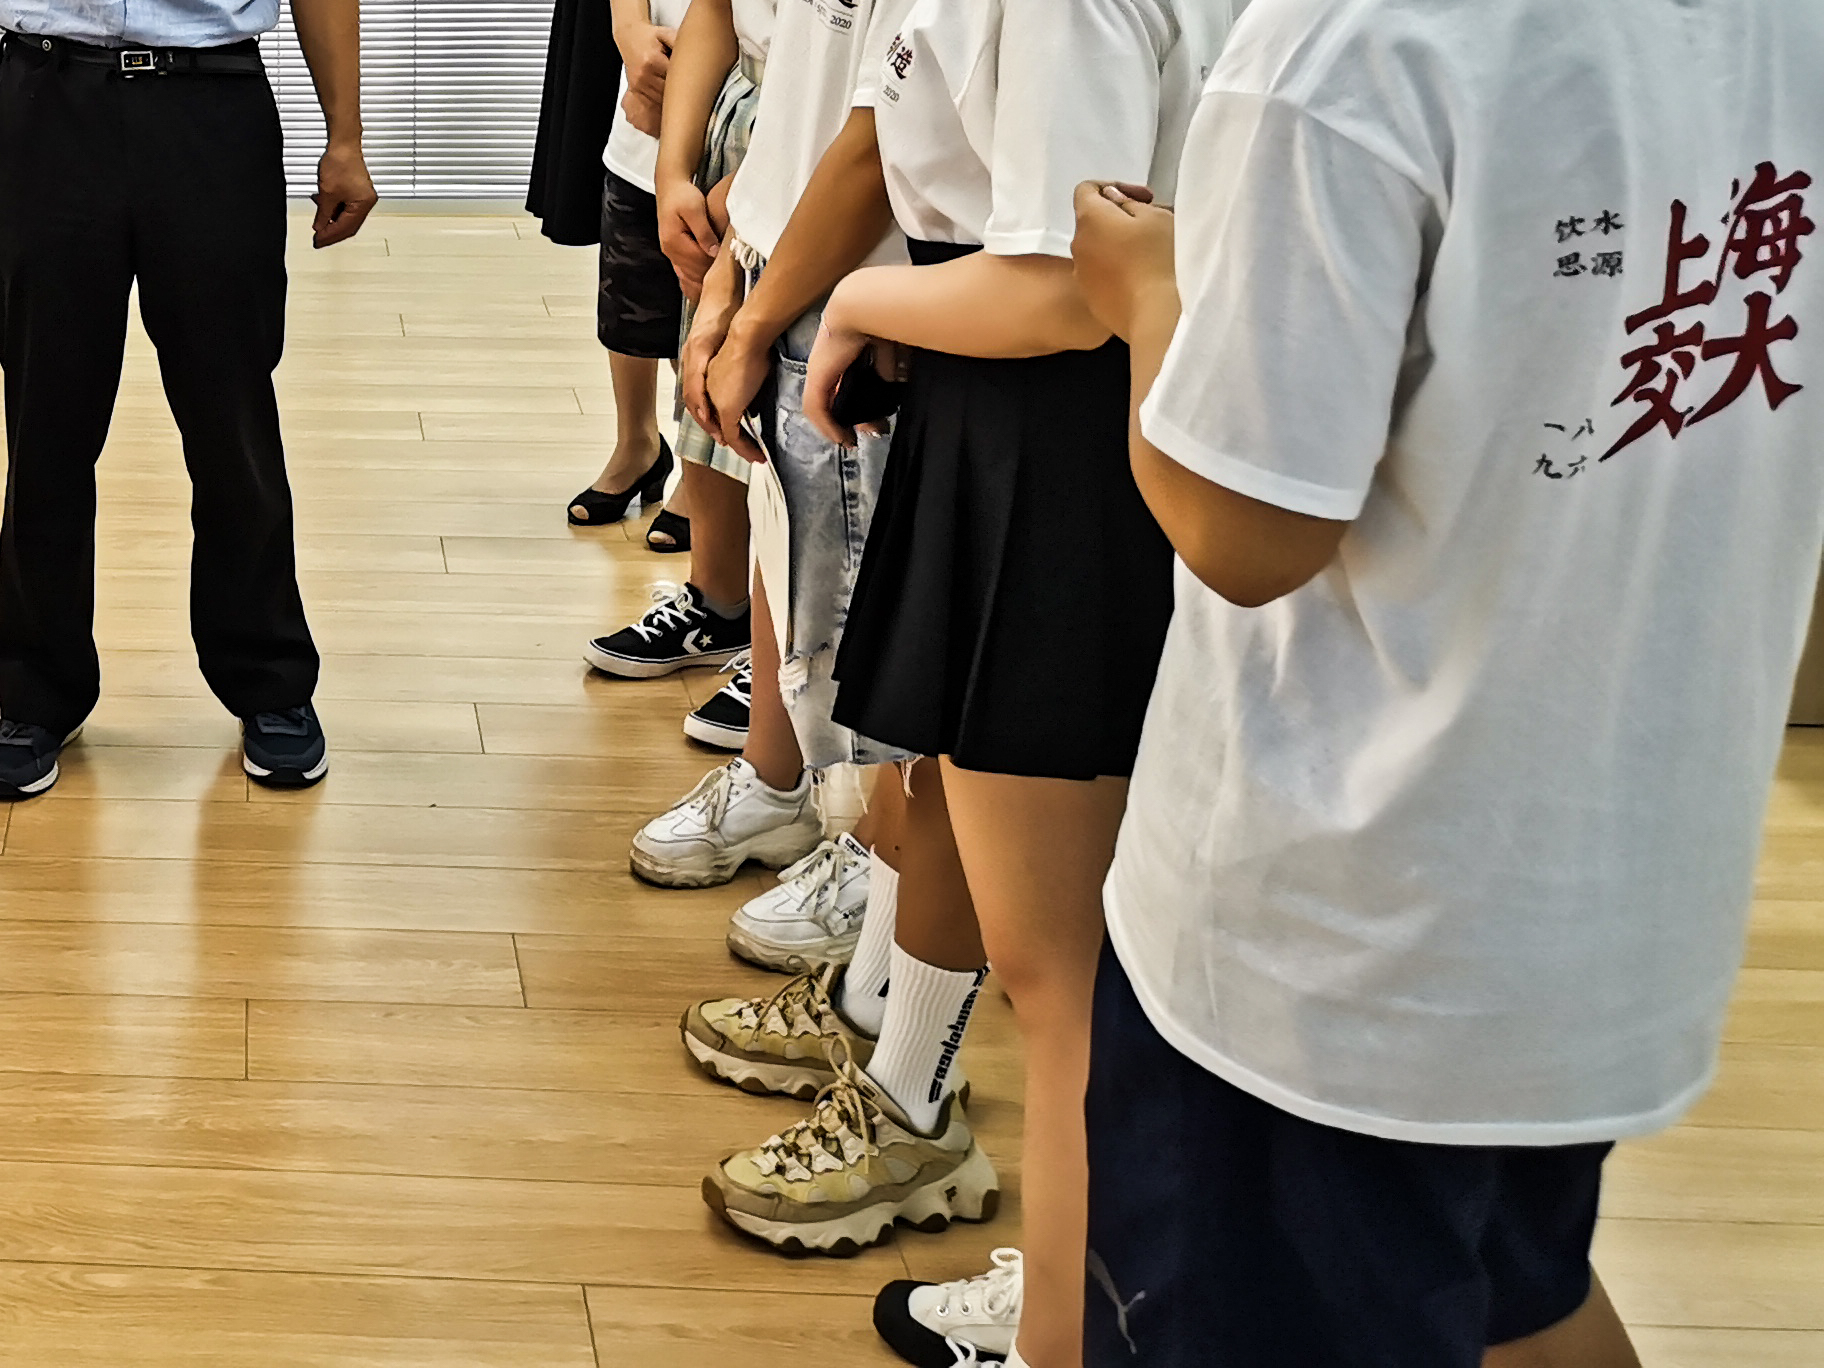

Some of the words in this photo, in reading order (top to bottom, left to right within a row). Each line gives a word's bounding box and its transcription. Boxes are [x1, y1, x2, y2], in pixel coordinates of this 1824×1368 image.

[830, 15, 853, 30] 2020
[1555, 210, 1625, 243] 饮水
[1553, 250, 1624, 278] 思源
